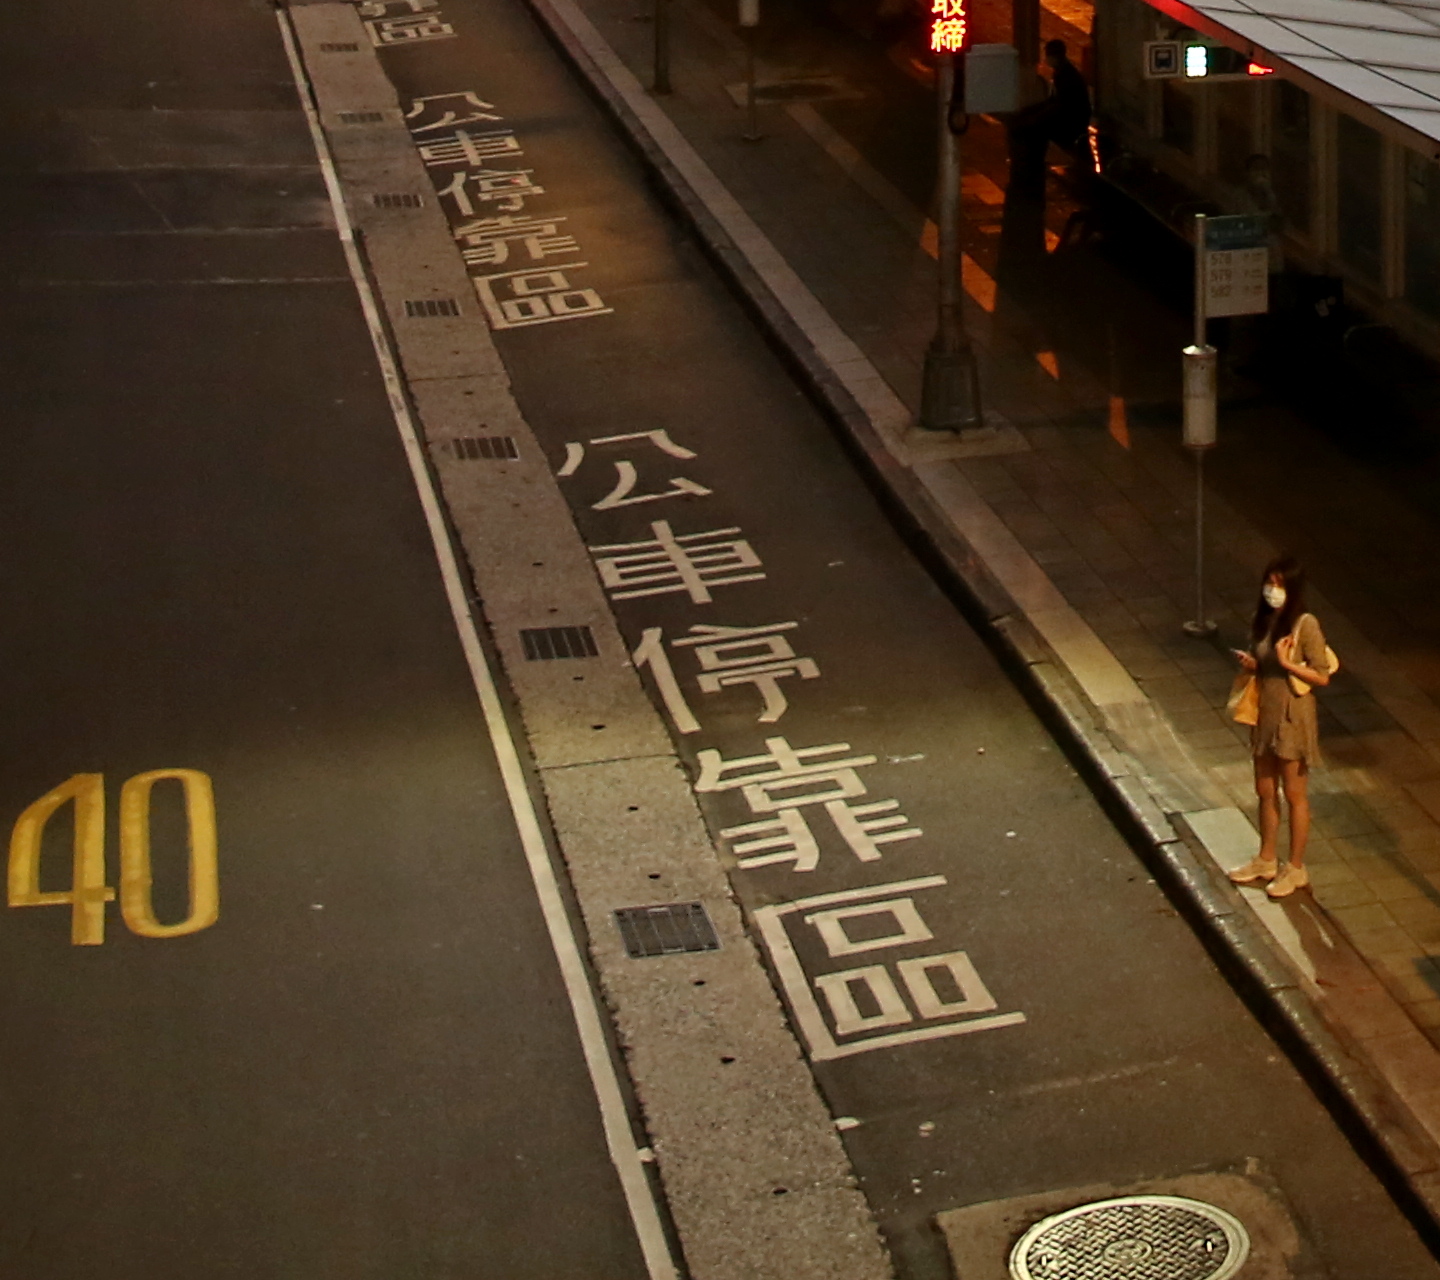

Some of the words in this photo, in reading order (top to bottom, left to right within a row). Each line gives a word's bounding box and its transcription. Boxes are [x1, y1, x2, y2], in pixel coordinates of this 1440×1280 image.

[405, 91, 614, 330] 公車停靠區
[6, 768, 219, 946] 40
[558, 429, 1027, 1061] 公車停靠區
